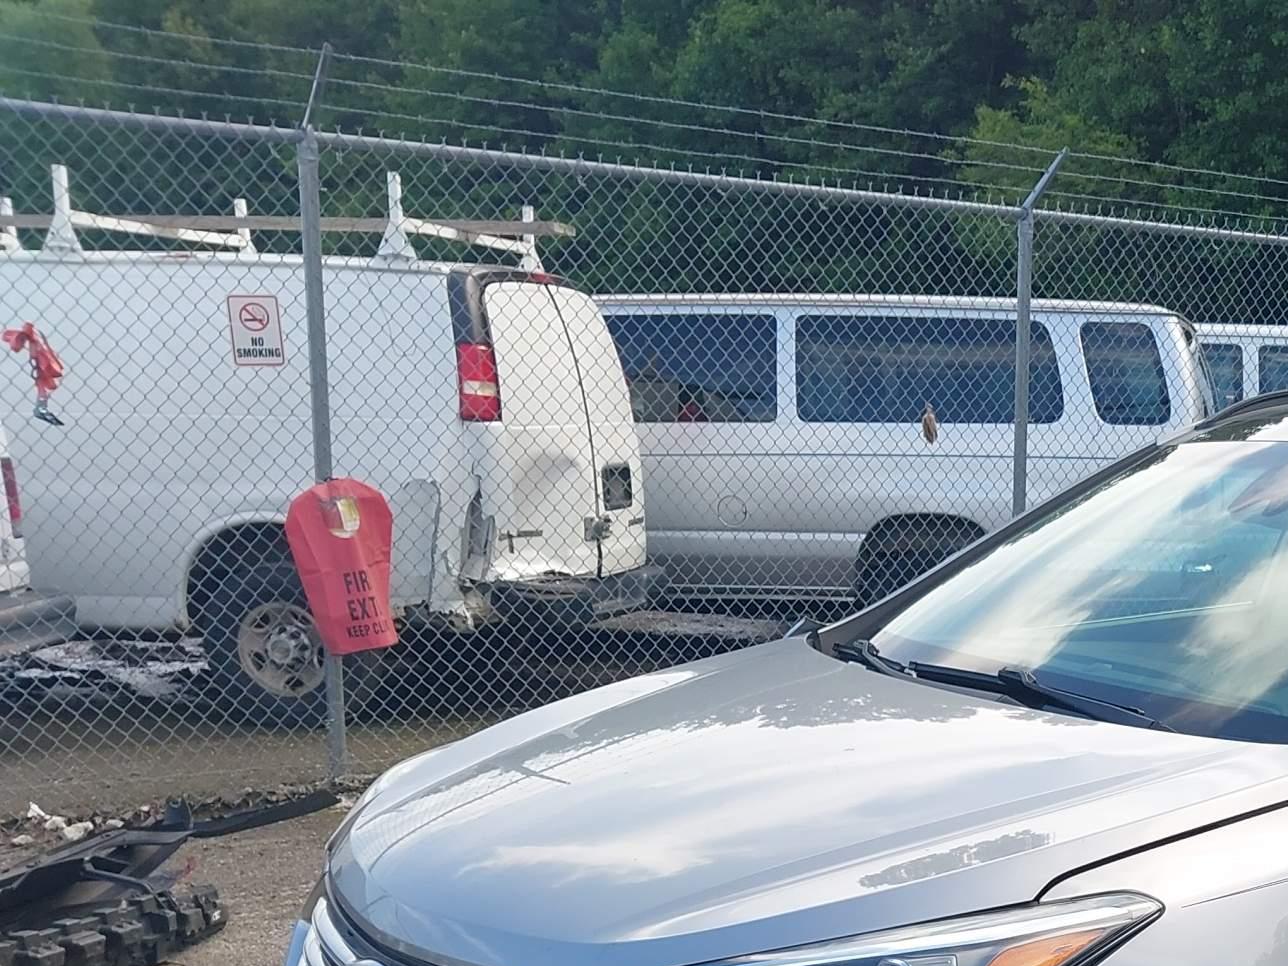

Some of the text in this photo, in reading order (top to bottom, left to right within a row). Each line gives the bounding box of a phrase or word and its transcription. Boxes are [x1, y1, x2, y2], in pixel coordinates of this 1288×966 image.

[251, 337, 264, 346] NO
[237, 348, 281, 358] SMOKING
[346, 625, 370, 638] KEEP
